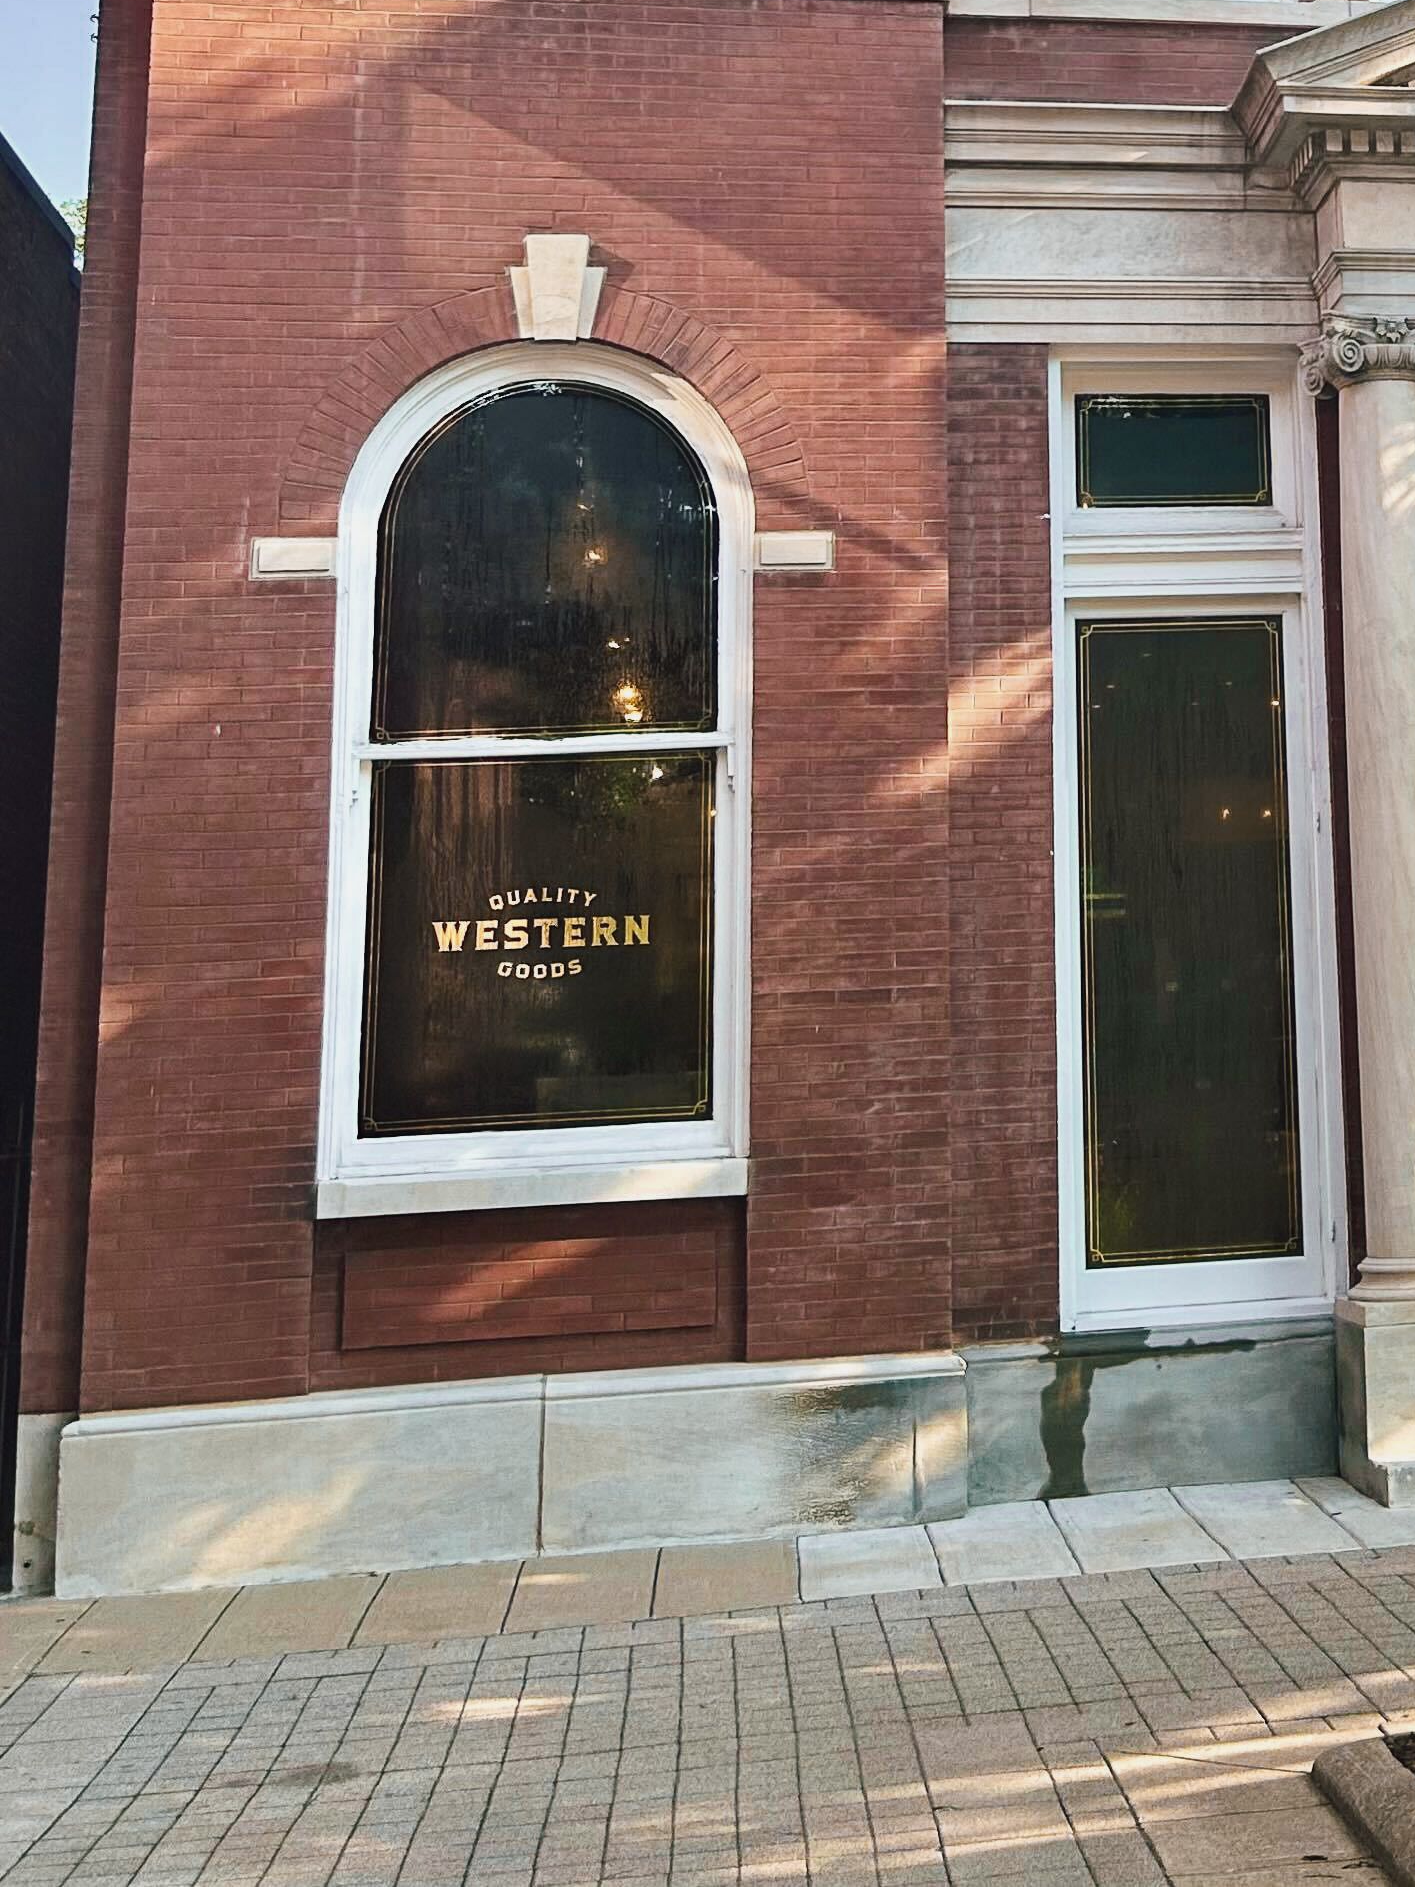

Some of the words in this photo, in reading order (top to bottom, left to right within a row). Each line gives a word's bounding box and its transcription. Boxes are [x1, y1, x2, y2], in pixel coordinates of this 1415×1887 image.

[488, 887, 597, 911] QUALITY
[432, 914, 650, 952] WESTERN
[497, 959, 582, 980] GOODS
